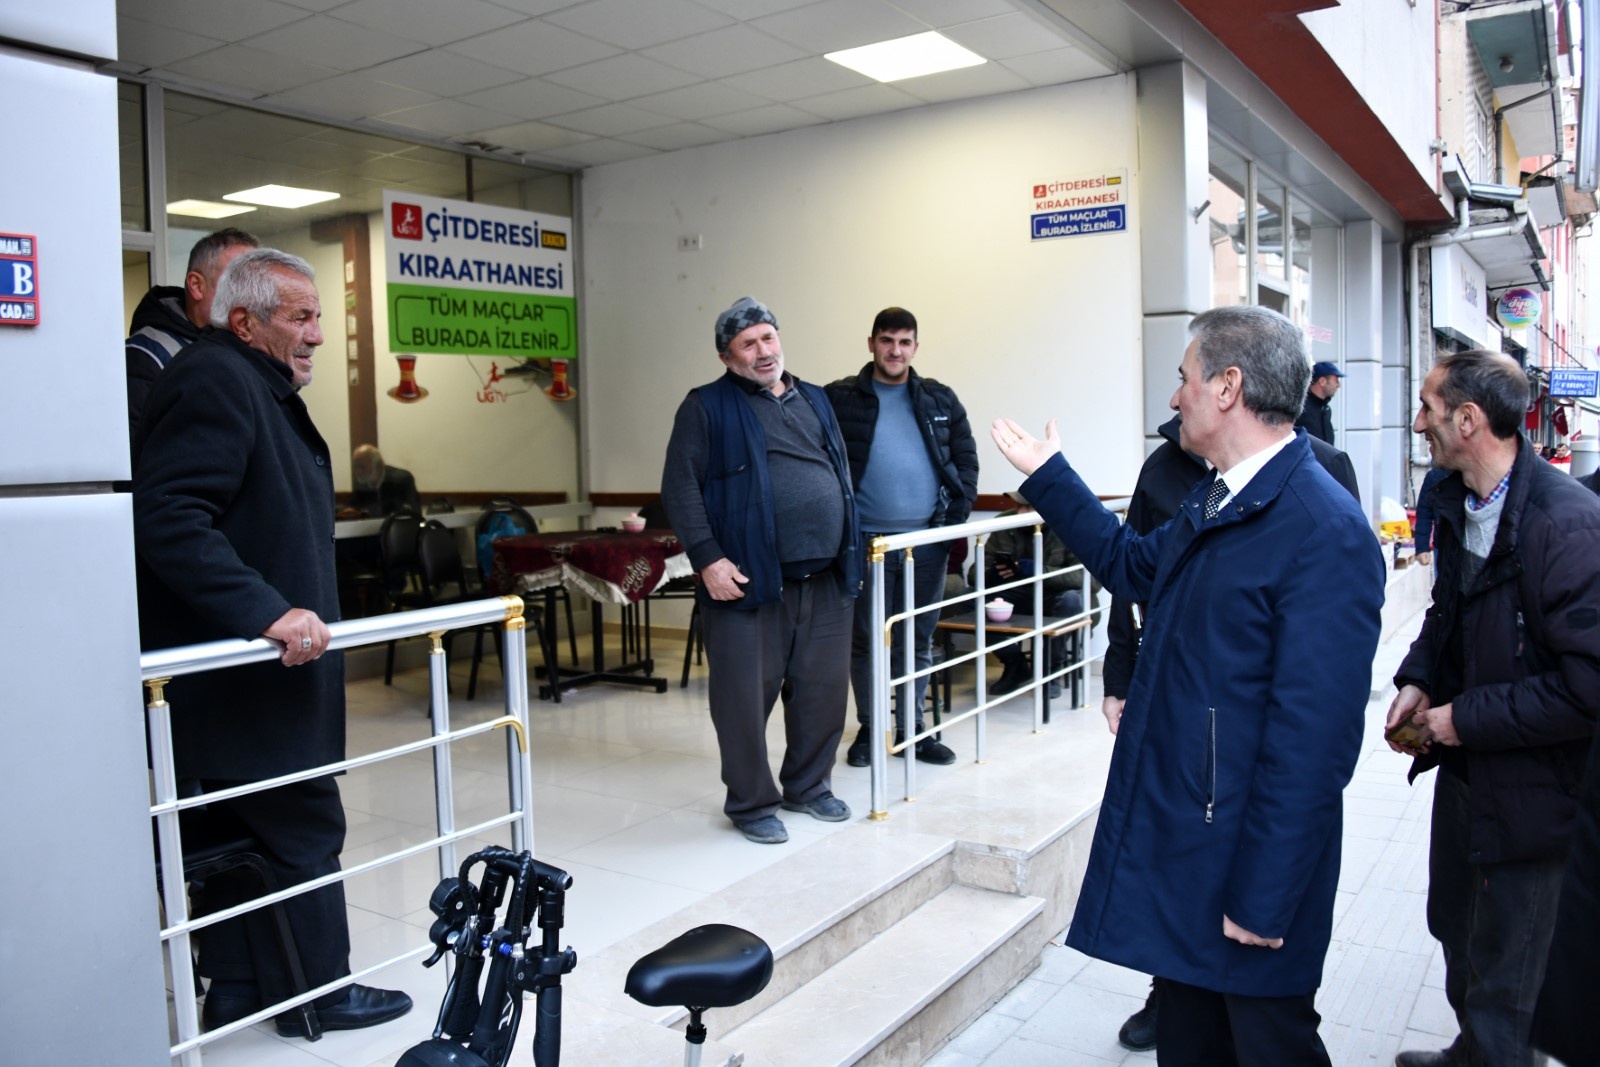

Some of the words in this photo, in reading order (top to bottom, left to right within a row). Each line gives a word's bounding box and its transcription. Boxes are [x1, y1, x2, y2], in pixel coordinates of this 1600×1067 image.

[1048, 175, 1105, 195] ÇİTDERESİ
[1036, 190, 1119, 210] KIRAATHANESİ
[426, 207, 539, 248] ÇİTDERESİ
[1048, 213, 1067, 224] TÜM
[1070, 210, 1108, 222] MAÇLAR
[1040, 225, 1079, 236] BURADA
[1081, 220, 1116, 232] İZLENİR
[399, 252, 563, 290] KIRAATHANESİ
[426, 293, 468, 317] TÜM
[473, 301, 543, 324] MAÇLAR
[412, 327, 491, 348] BURADA
[495, 327, 559, 350] İZLENİR
